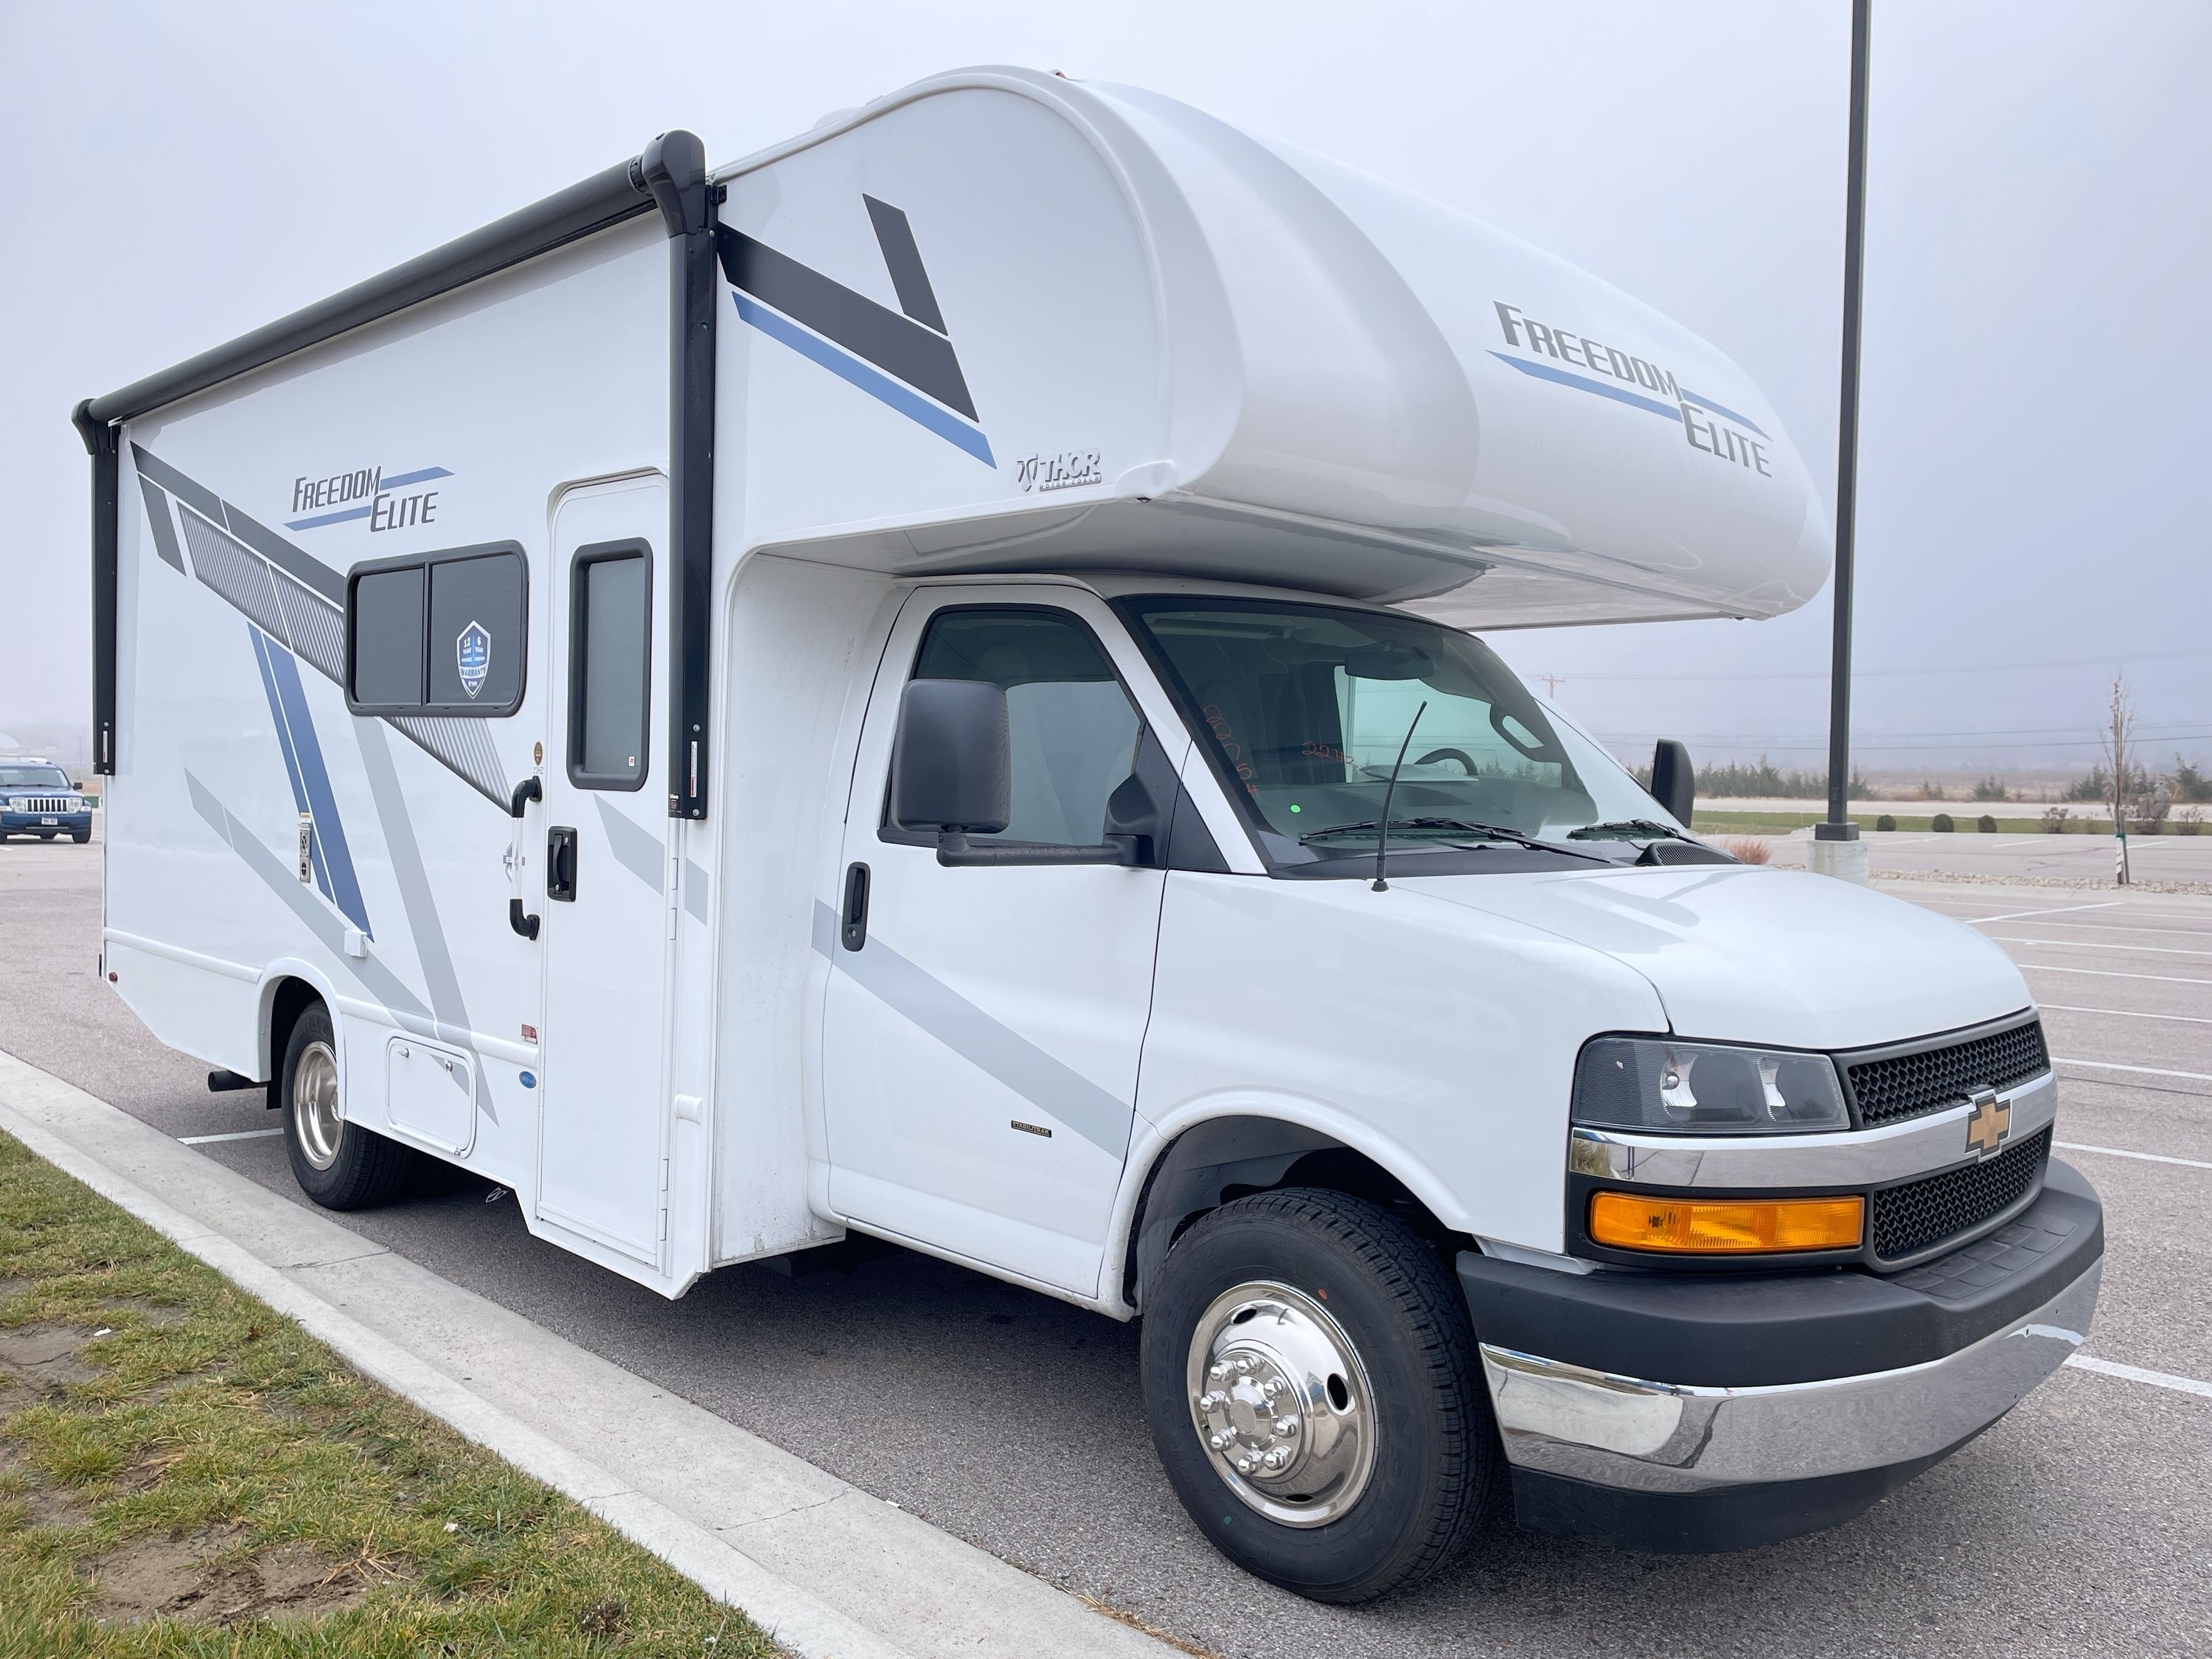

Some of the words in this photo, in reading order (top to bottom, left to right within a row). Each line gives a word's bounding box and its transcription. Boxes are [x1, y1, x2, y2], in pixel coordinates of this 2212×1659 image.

[1493, 300, 1683, 403] FREEDOM
[1680, 403, 1773, 478] ELITE
[1040, 448, 1101, 481] THOR
[1040, 481, 1067, 490] MOTOR
[1071, 476, 1099, 485] COACH
[292, 465, 381, 512] FREEDOM
[370, 491, 439, 532] ELITE
[464, 637, 471, 647] 12
[477, 636, 481, 646] 6
[461, 667, 486, 676] WARRANTY
